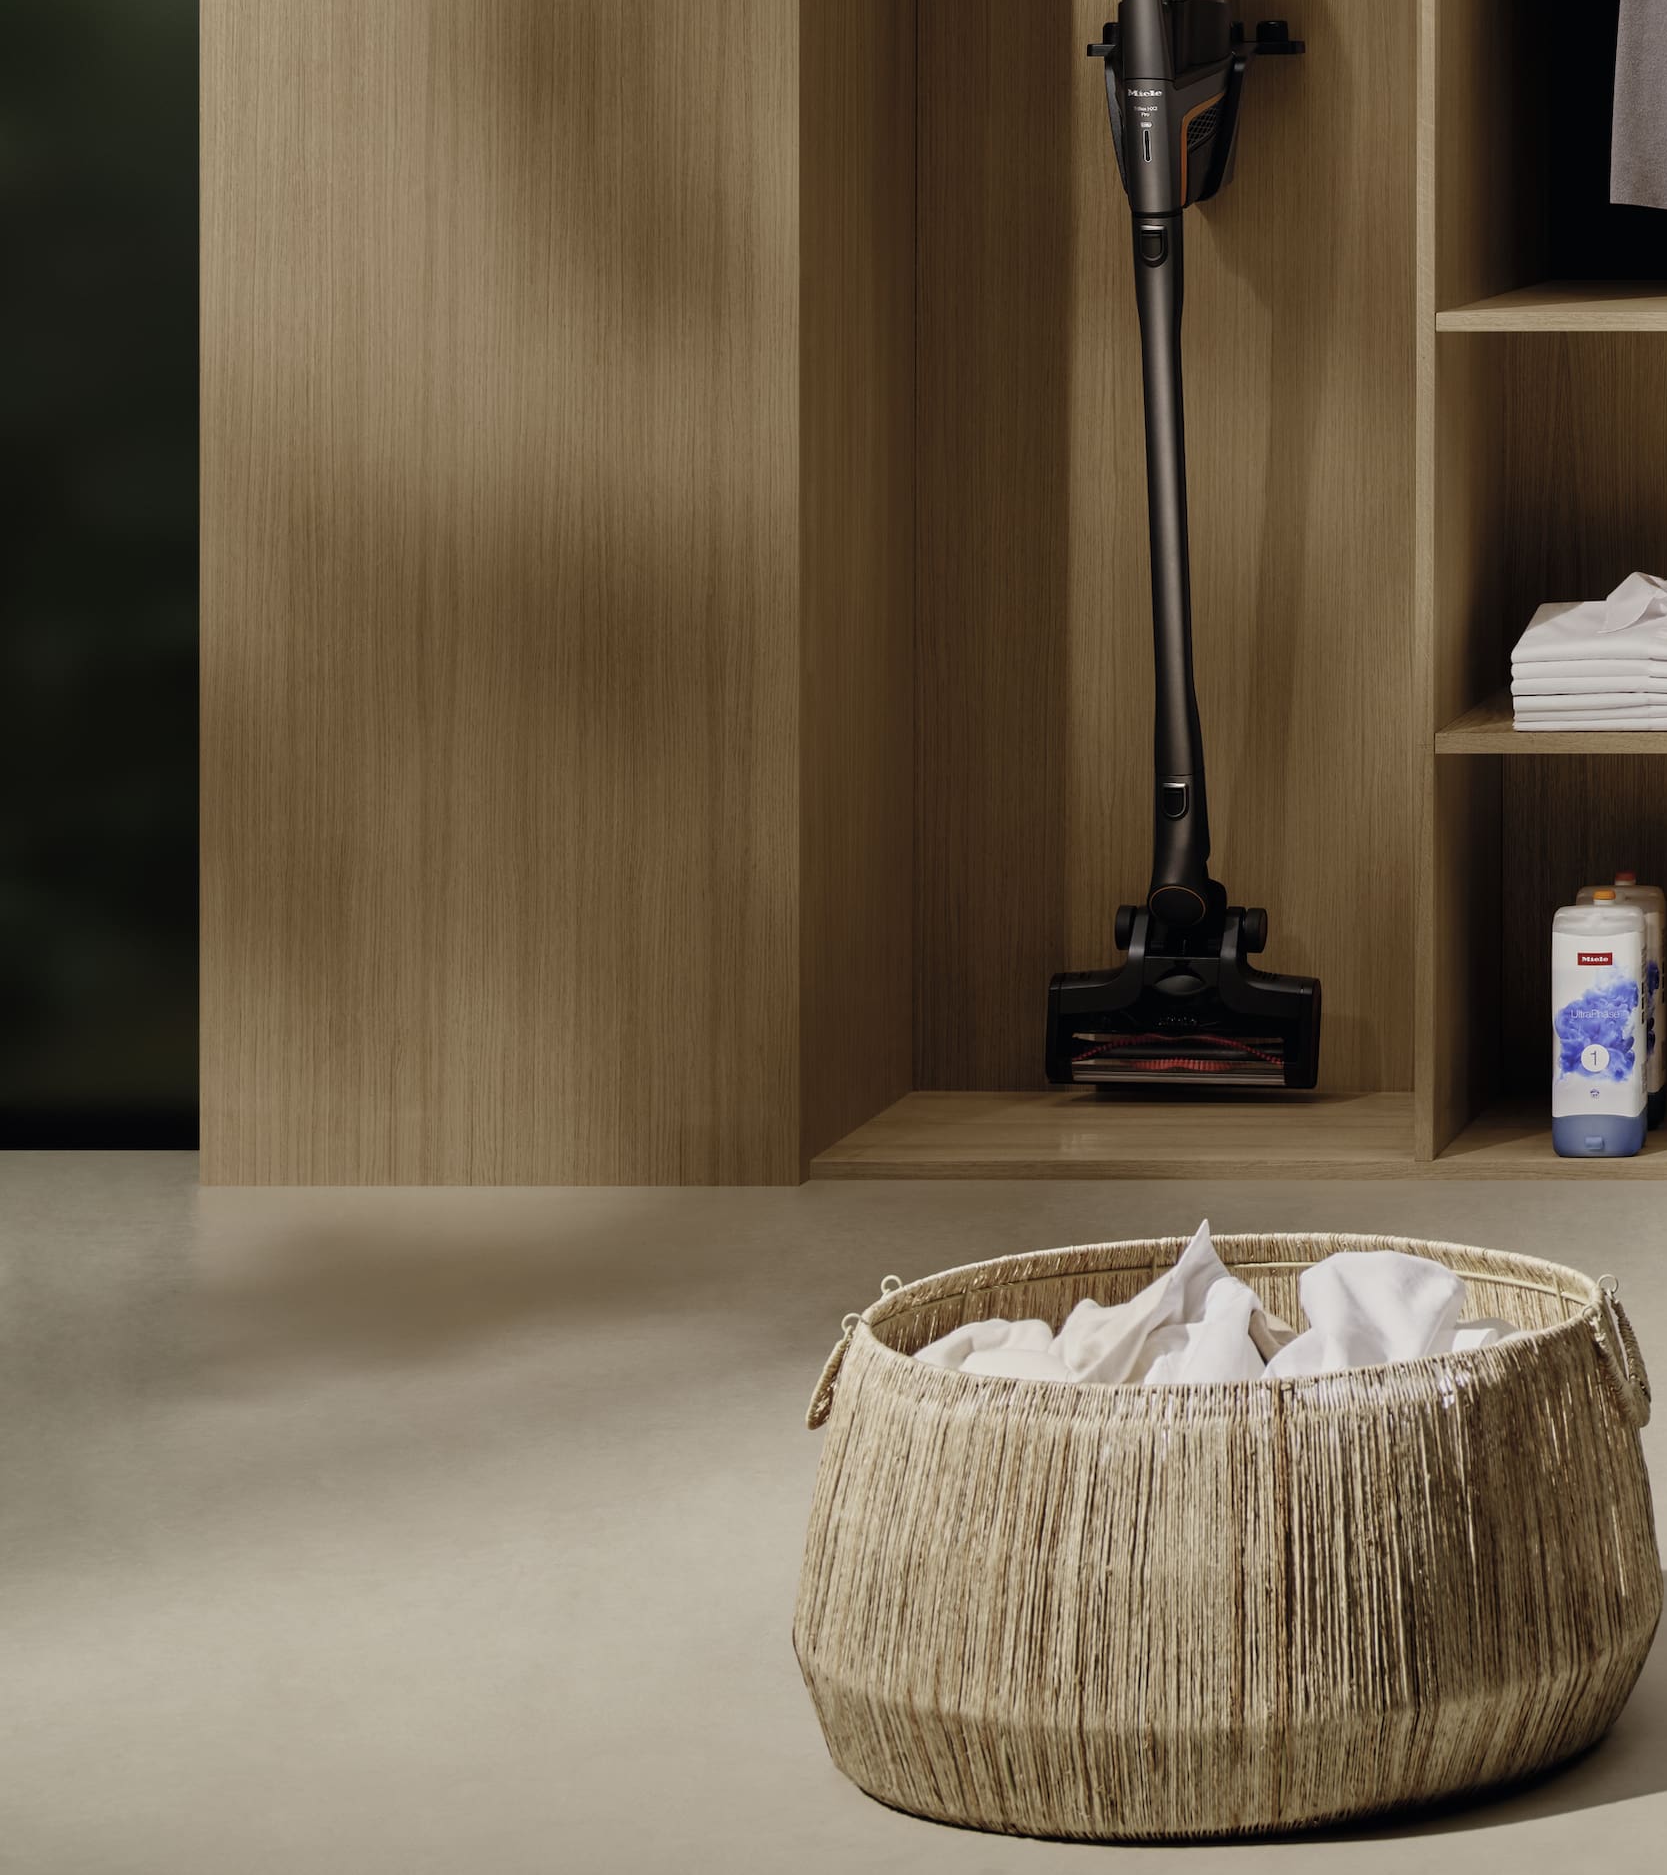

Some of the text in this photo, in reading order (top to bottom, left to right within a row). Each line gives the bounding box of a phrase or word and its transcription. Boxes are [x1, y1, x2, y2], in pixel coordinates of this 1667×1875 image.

[1128, 88, 1162, 97] Miele
[1581, 955, 1609, 963] Miele
[1570, 1009, 1620, 1019] UltraPhase
[1590, 1050, 1597, 1066] 1
